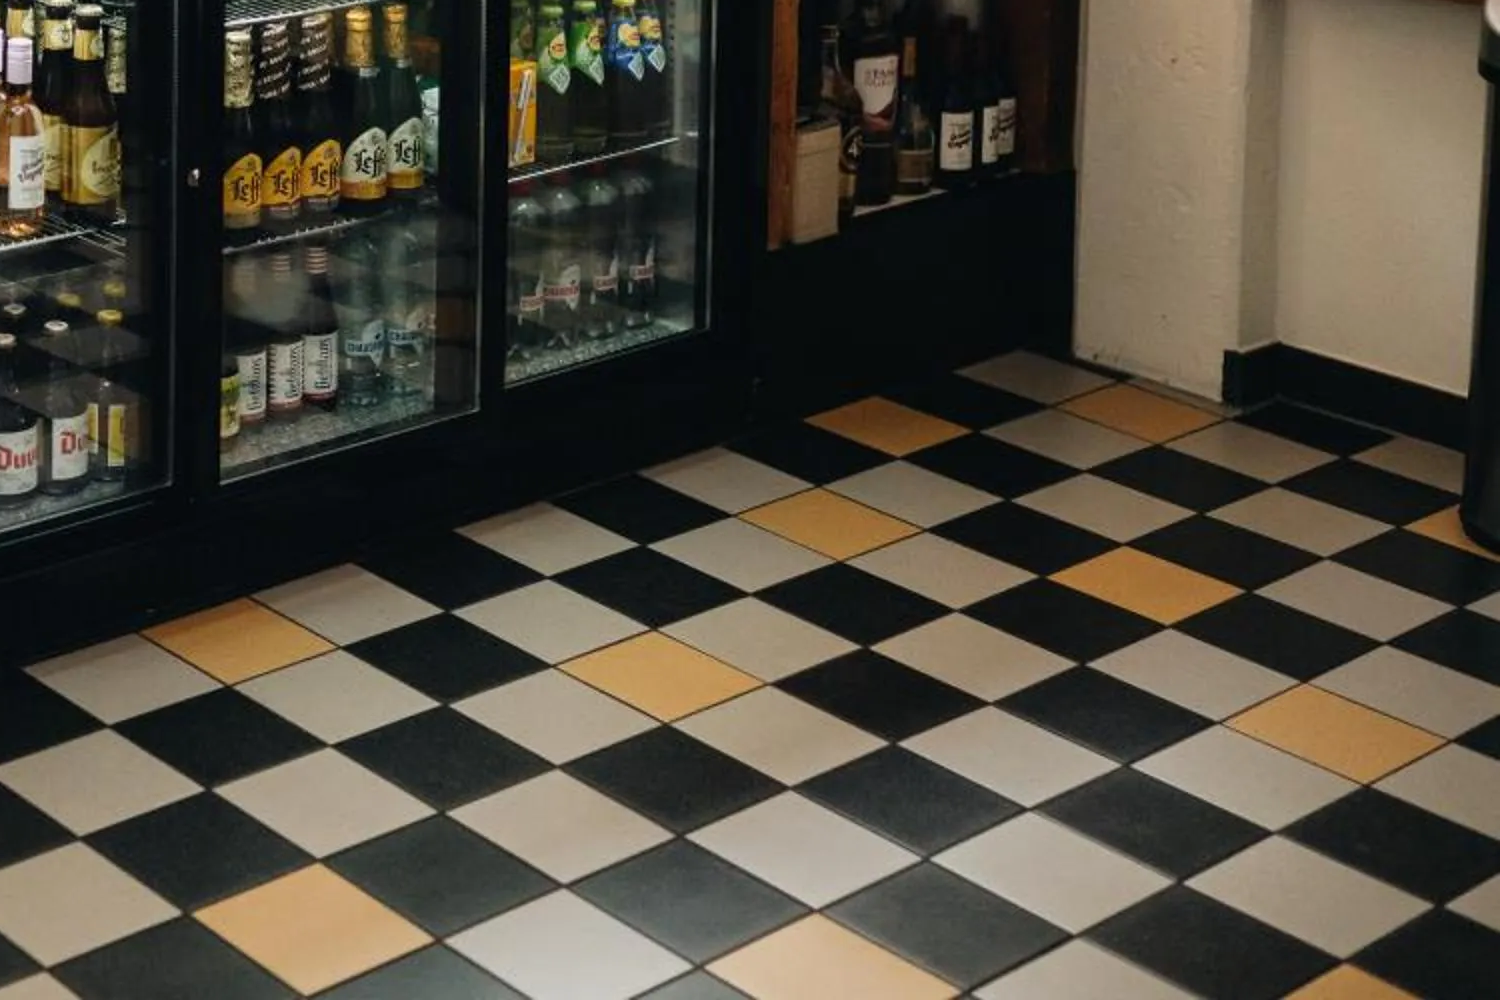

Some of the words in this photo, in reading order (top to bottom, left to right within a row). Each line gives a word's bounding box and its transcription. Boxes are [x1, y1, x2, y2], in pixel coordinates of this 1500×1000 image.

[352, 145, 387, 179] Leff
[394, 135, 422, 168] Leff
[230, 171, 261, 204] Leff
[310, 157, 340, 190] Leff
